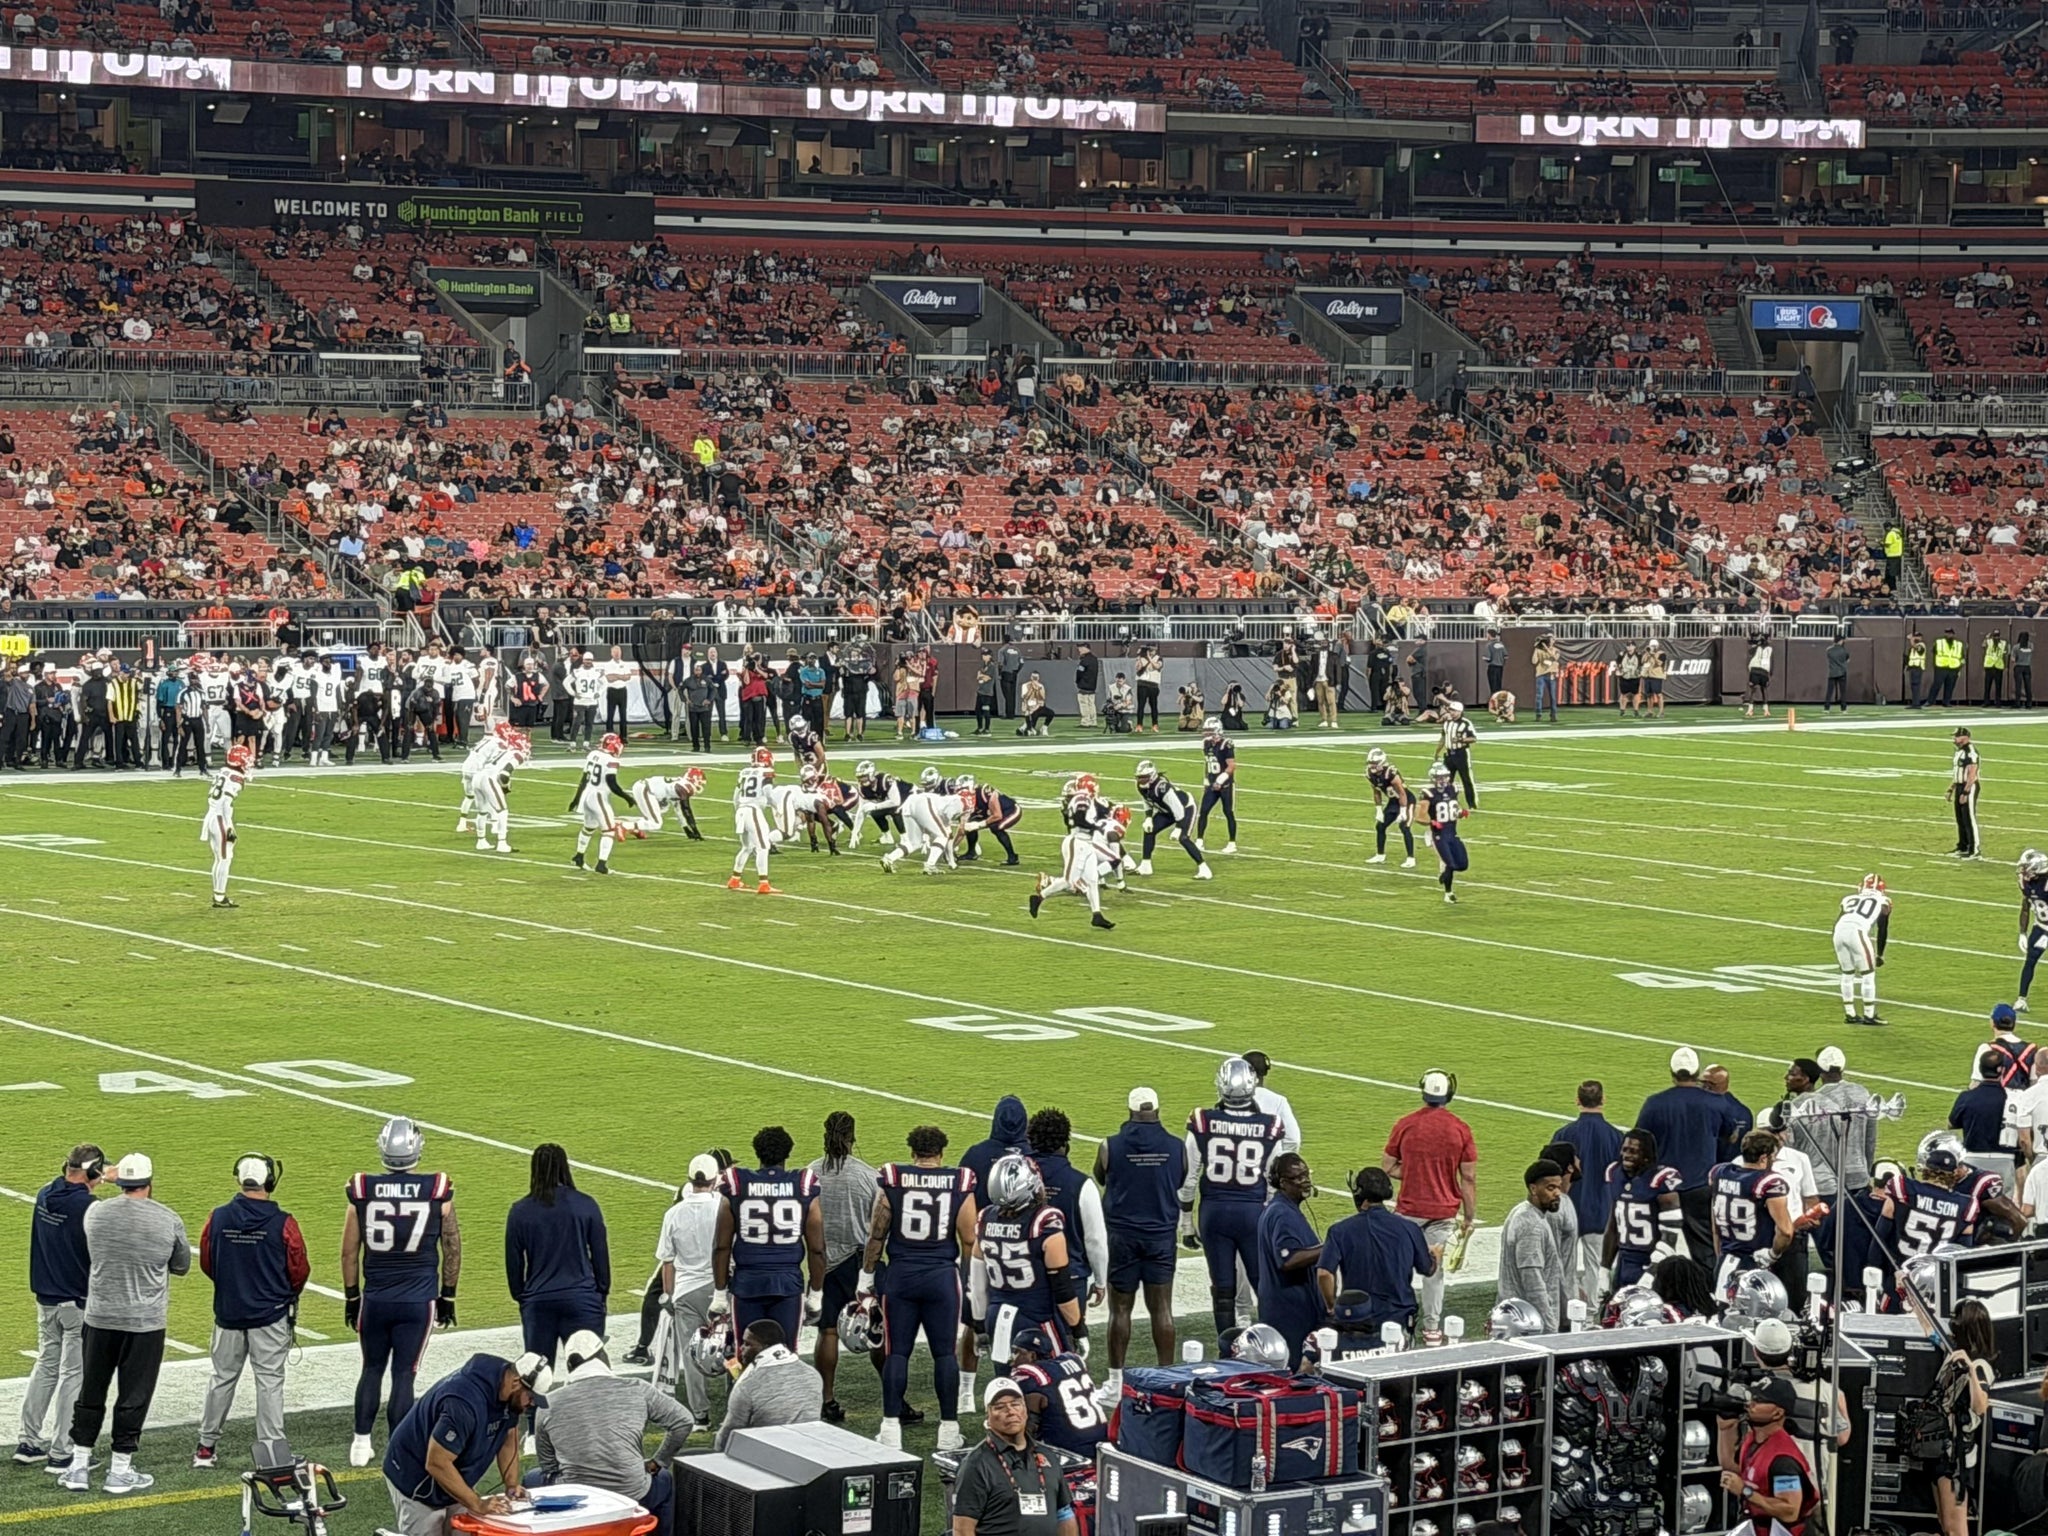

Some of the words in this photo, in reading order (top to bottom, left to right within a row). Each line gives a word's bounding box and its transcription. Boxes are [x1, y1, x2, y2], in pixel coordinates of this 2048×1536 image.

[273, 199, 360, 218] WELCOME
[366, 202, 388, 219] TO
[420, 204, 501, 226] Huntington
[503, 207, 540, 224] Bank
[545, 211, 584, 223] FIELD
[450, 280, 507, 296] Huntington
[507, 282, 534, 295] Bank
[902, 288, 943, 309] Bally
[943, 296, 957, 306] BET
[1326, 299, 1364, 319] Bally
[1364, 306, 1378, 316] BET
[1779, 308, 1798, 316] BUD
[207, 685, 225, 700] 67
[325, 682, 333, 697] 8
[580, 679, 596, 694] 34
[1843, 897, 1878, 919] 20
[905, 1006, 1216, 1041] 50
[98, 1059, 416, 1099] 40
[1209, 1119, 1265, 1138] CROWNOVER
[1206, 1137, 1264, 1185] 68
[375, 1183, 421, 1198] CONLEY
[748, 1182, 794, 1197] MORGAN
[901, 1172, 955, 1190] DALCOURT
[900, 1190, 952, 1241] 61
[1916, 1194, 1959, 1218] WILSON
[366, 1201, 430, 1252] 67
[739, 1199, 802, 1244] 69
[985, 1222, 1022, 1239] ROGERS
[1897, 1209, 1956, 1256] 51
[980, 1240, 1035, 1289] 65
